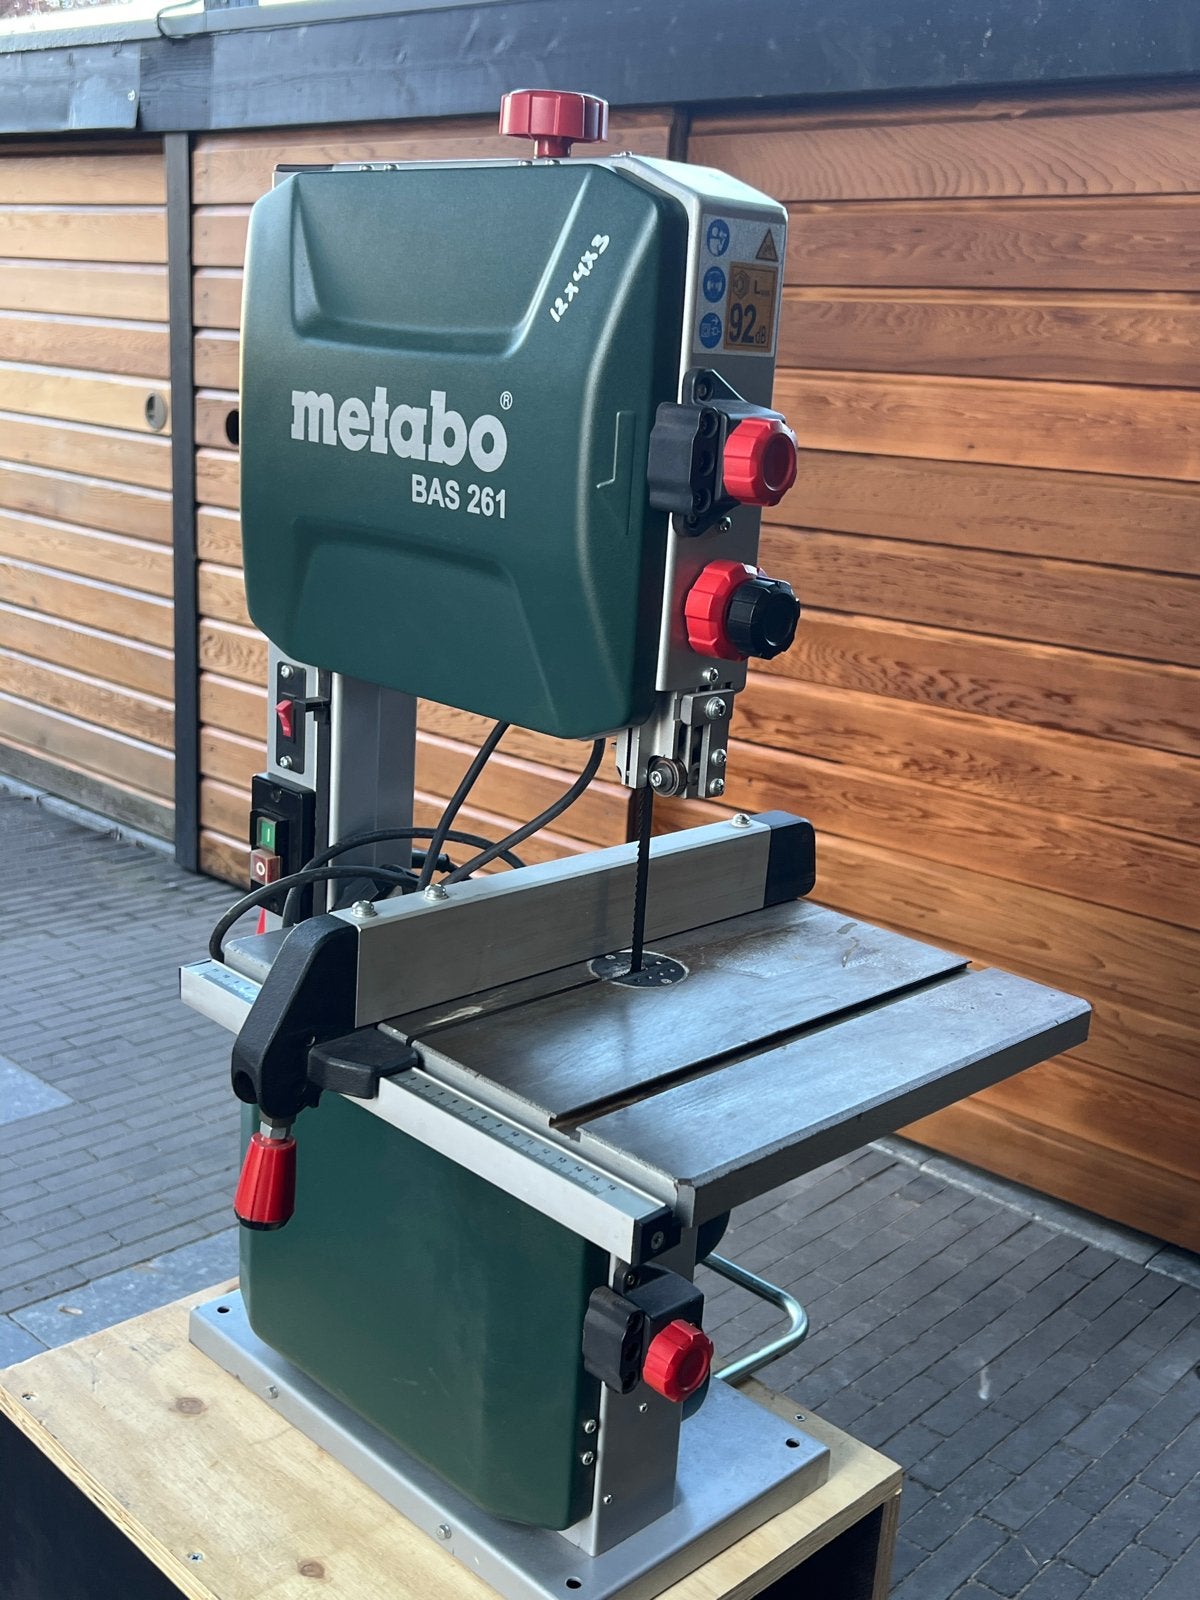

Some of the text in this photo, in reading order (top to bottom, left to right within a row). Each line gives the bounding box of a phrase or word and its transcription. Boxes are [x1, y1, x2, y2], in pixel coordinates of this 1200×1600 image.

[729, 303, 757, 343] 92
[290, 386, 508, 473] metabo
[411, 473, 506, 519] BAS 261
